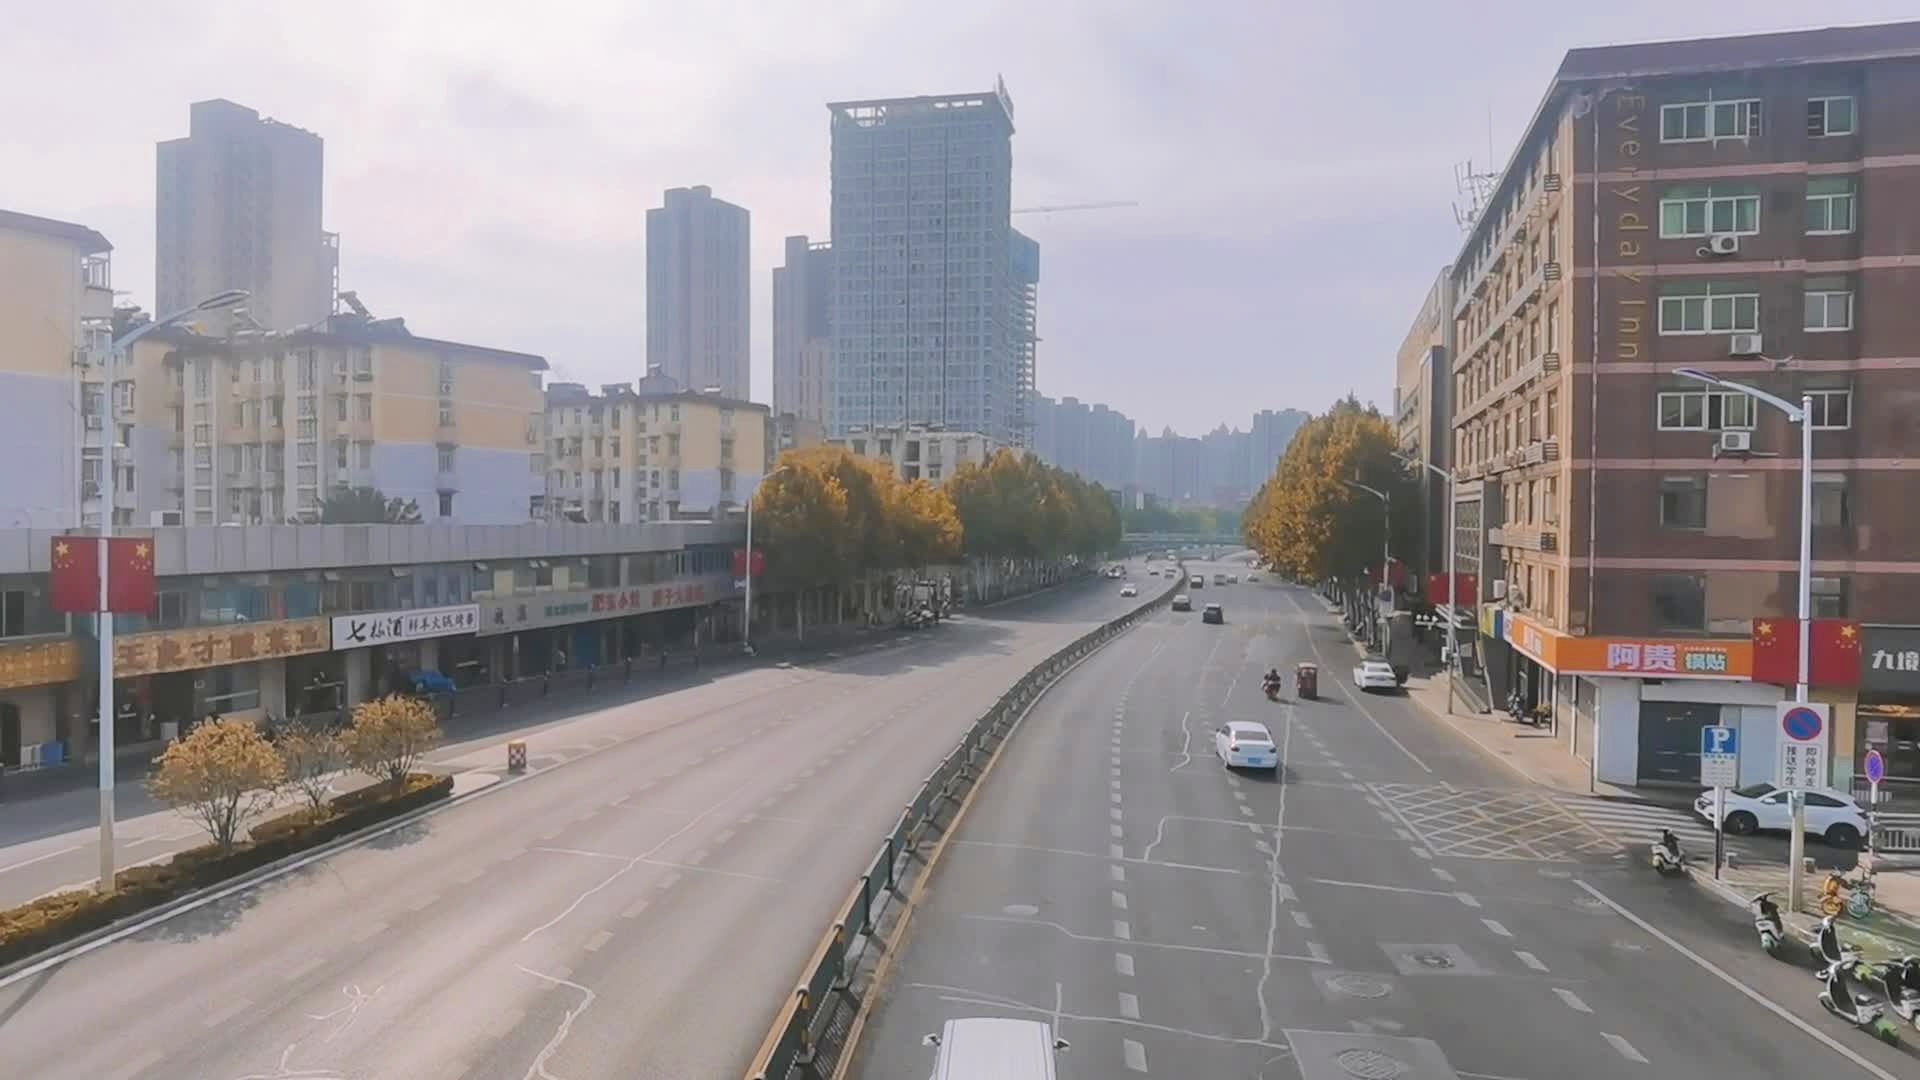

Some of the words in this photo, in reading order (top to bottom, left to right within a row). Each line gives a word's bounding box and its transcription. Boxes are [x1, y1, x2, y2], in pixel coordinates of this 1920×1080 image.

[1613, 94, 1648, 283] Everyday
[1618, 299, 1647, 359] Inn
[1607, 644, 1676, 671] 阿贵
[1711, 728, 1729, 752] P
